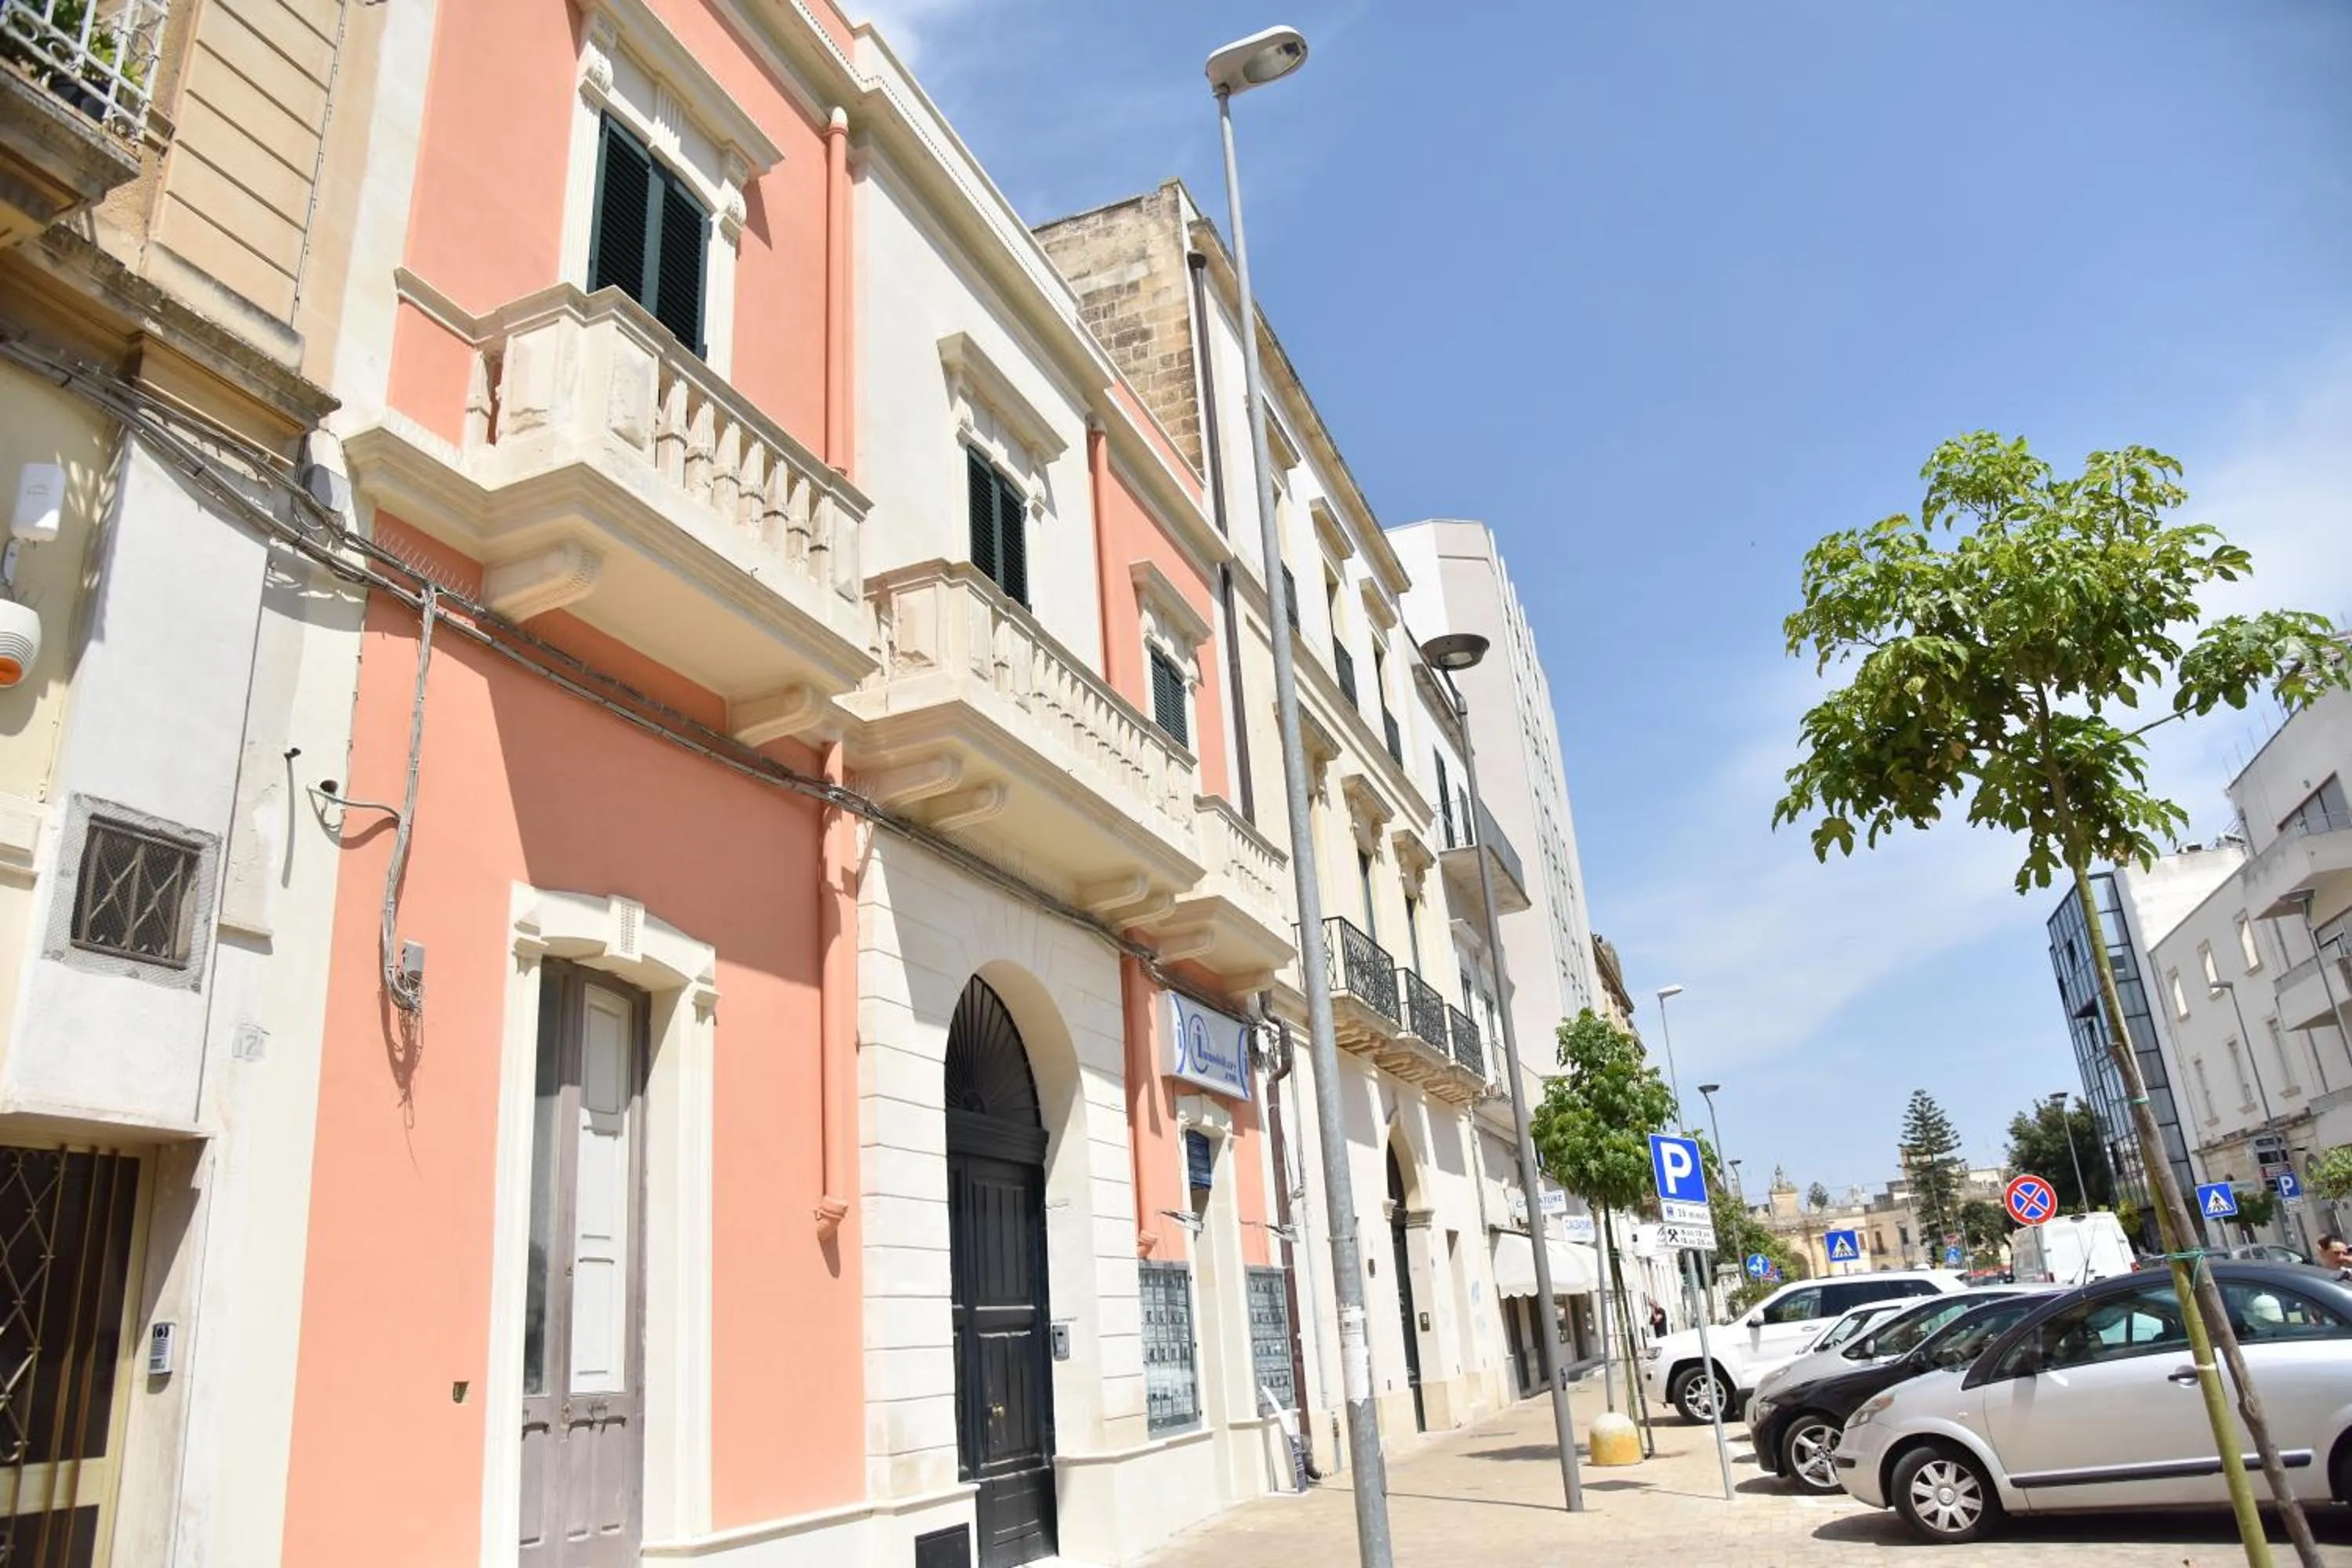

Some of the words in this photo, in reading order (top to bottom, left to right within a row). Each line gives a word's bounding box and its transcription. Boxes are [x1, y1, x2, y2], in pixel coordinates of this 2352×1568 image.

[1660, 1141, 1693, 1194] P
[2279, 1175, 2294, 1196] P
[1516, 1194, 1563, 1207] CATURE
